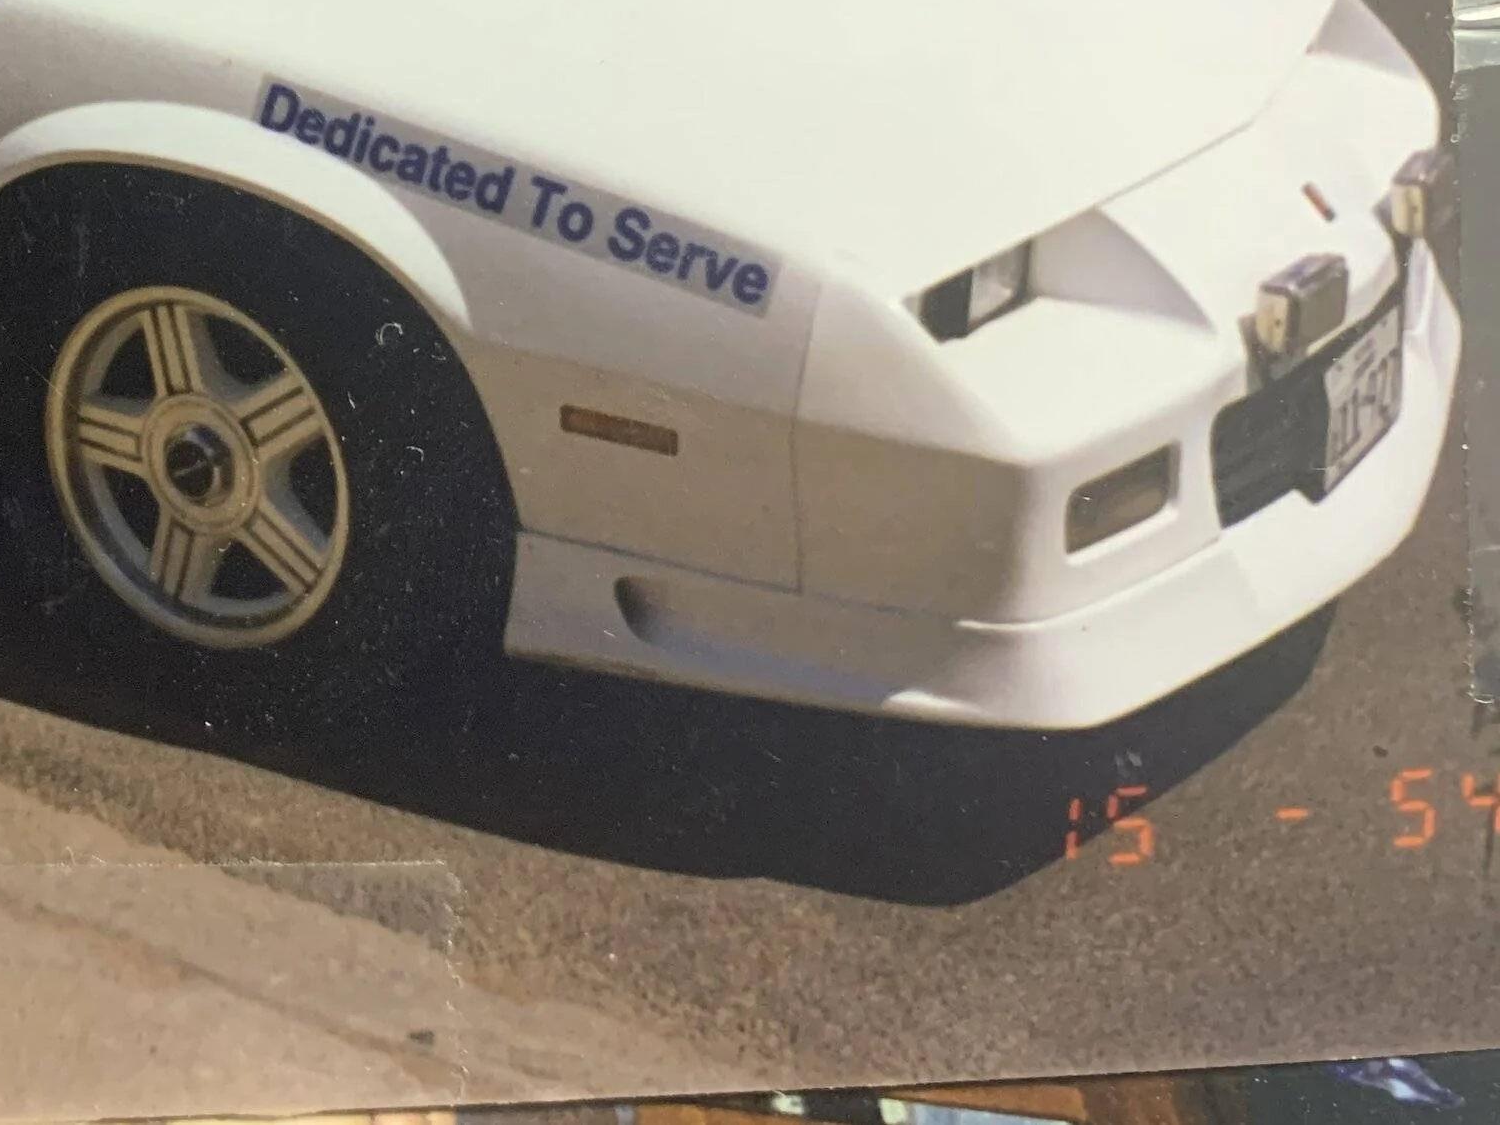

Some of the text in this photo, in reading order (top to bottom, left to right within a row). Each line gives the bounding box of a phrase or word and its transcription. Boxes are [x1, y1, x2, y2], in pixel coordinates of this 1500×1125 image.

[260, 82, 770, 306] Dedicated To Serve
